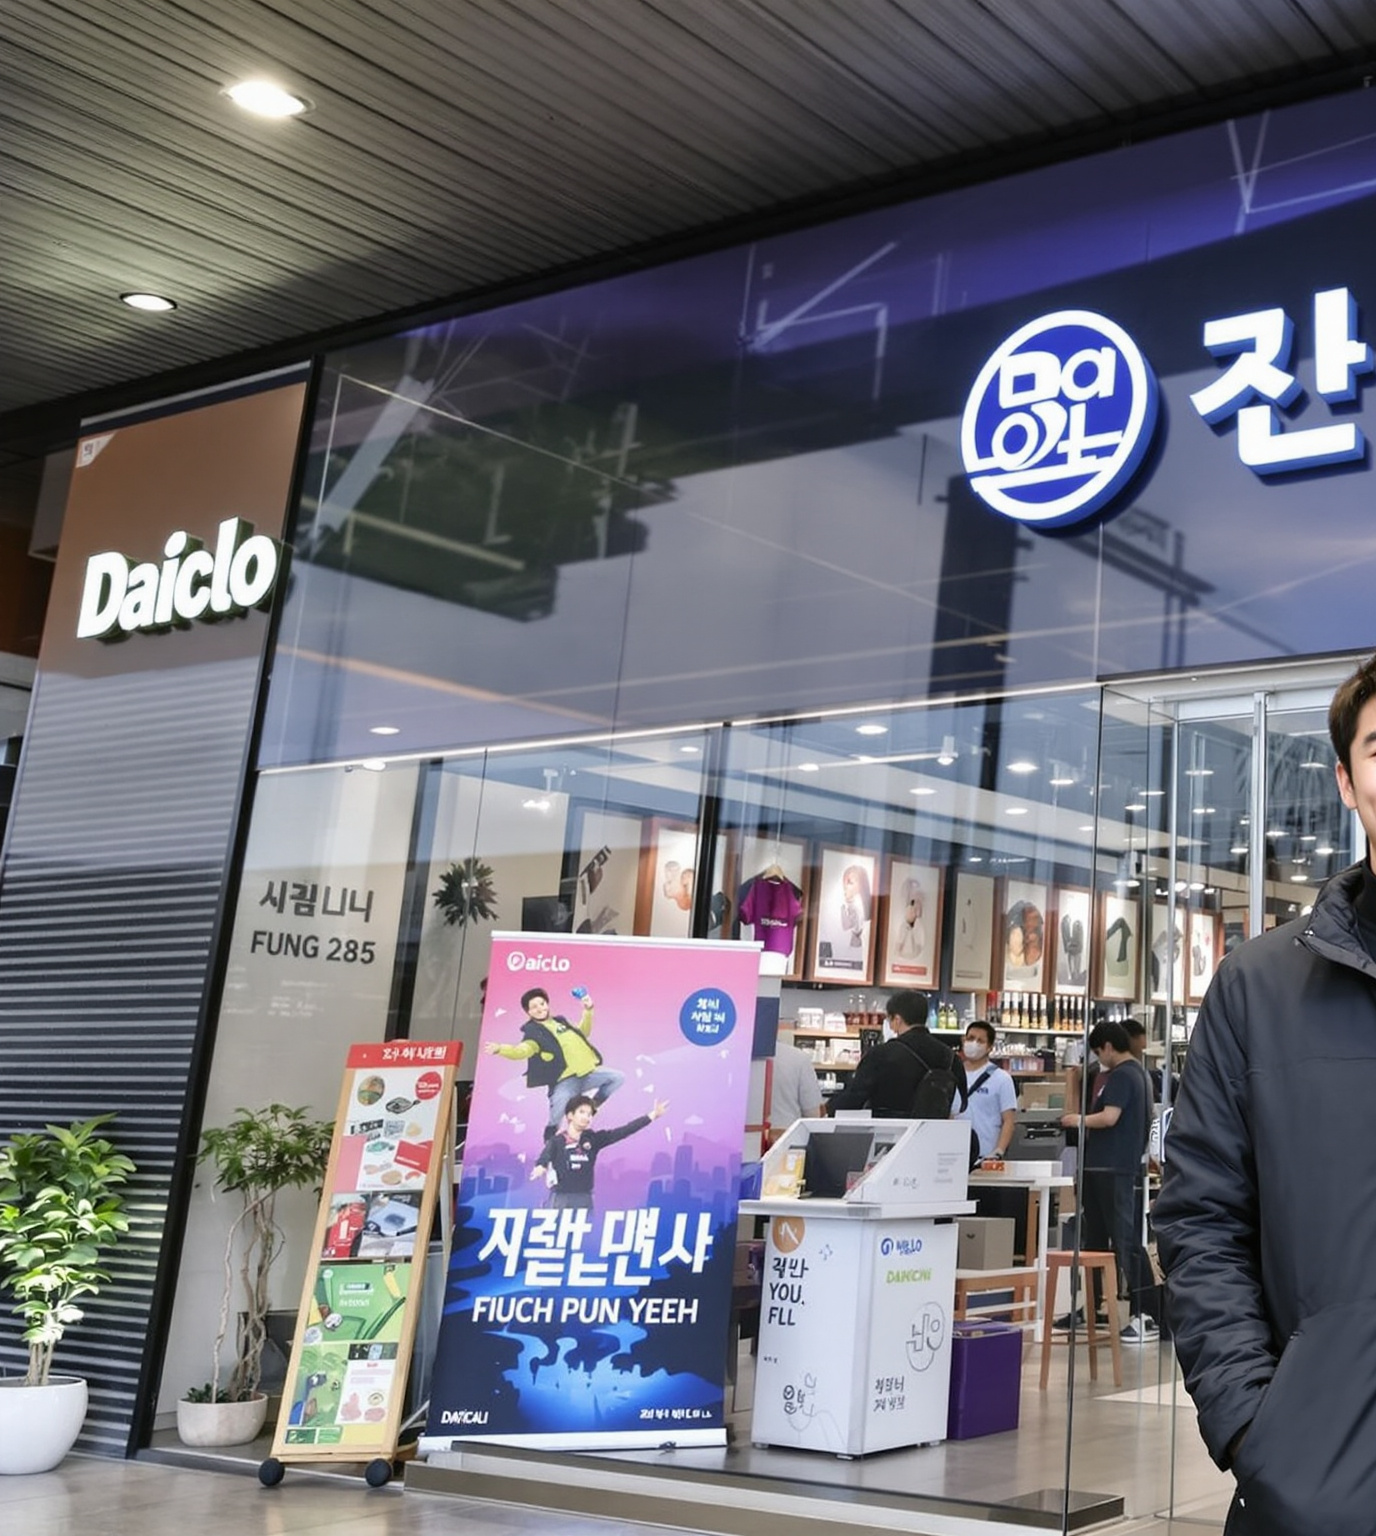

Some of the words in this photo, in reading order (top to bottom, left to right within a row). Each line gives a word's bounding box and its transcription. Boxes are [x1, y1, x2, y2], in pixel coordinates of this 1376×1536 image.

[76, 516, 280, 640] Daiclo
[250, 929, 320, 959] FUNG
[325, 936, 377, 965] 285
[471, 1296, 554, 1324] FIUCH
[560, 1297, 621, 1325] PUN
[628, 1298, 700, 1325] YEEH
[767, 1305, 797, 1327] FLL
